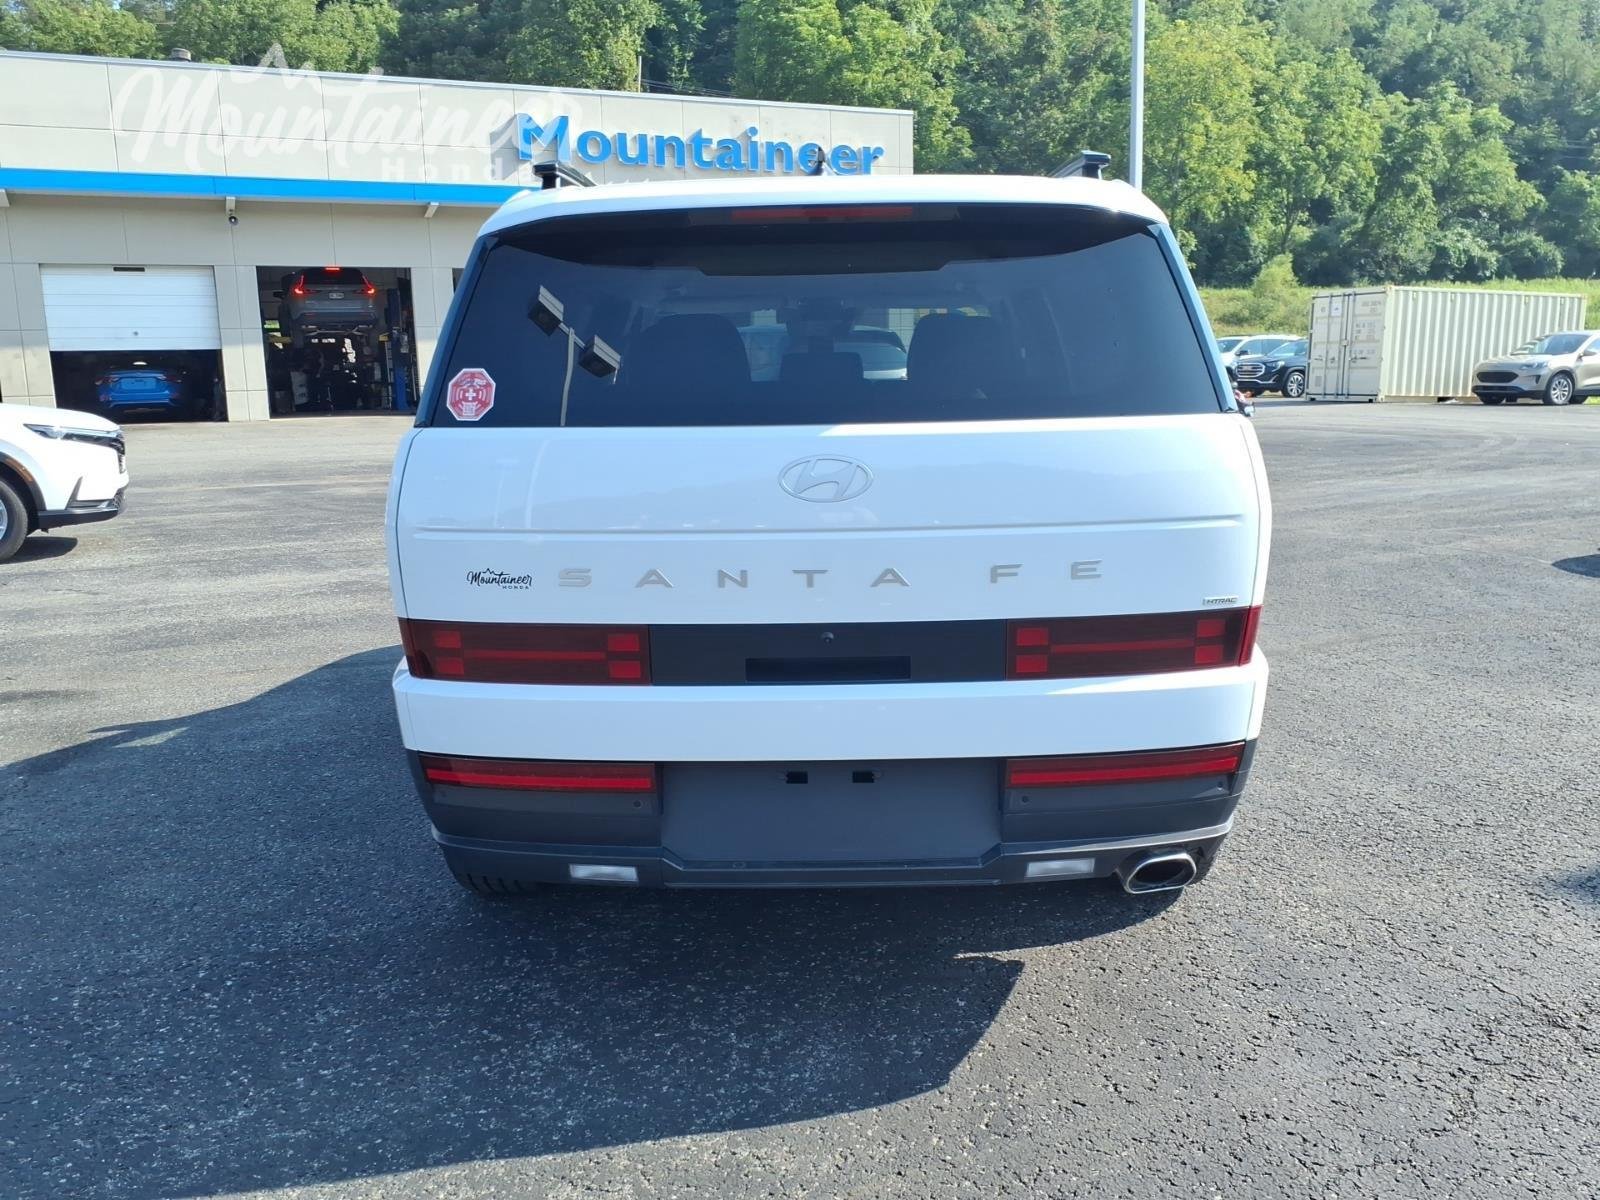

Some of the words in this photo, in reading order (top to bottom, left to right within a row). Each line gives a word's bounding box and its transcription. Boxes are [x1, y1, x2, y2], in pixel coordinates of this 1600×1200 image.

[516, 113, 884, 175] Mountaineer
[466, 568, 533, 587] Mountaineer
[558, 567, 911, 588] SANTA
[989, 560, 1103, 584] FE
